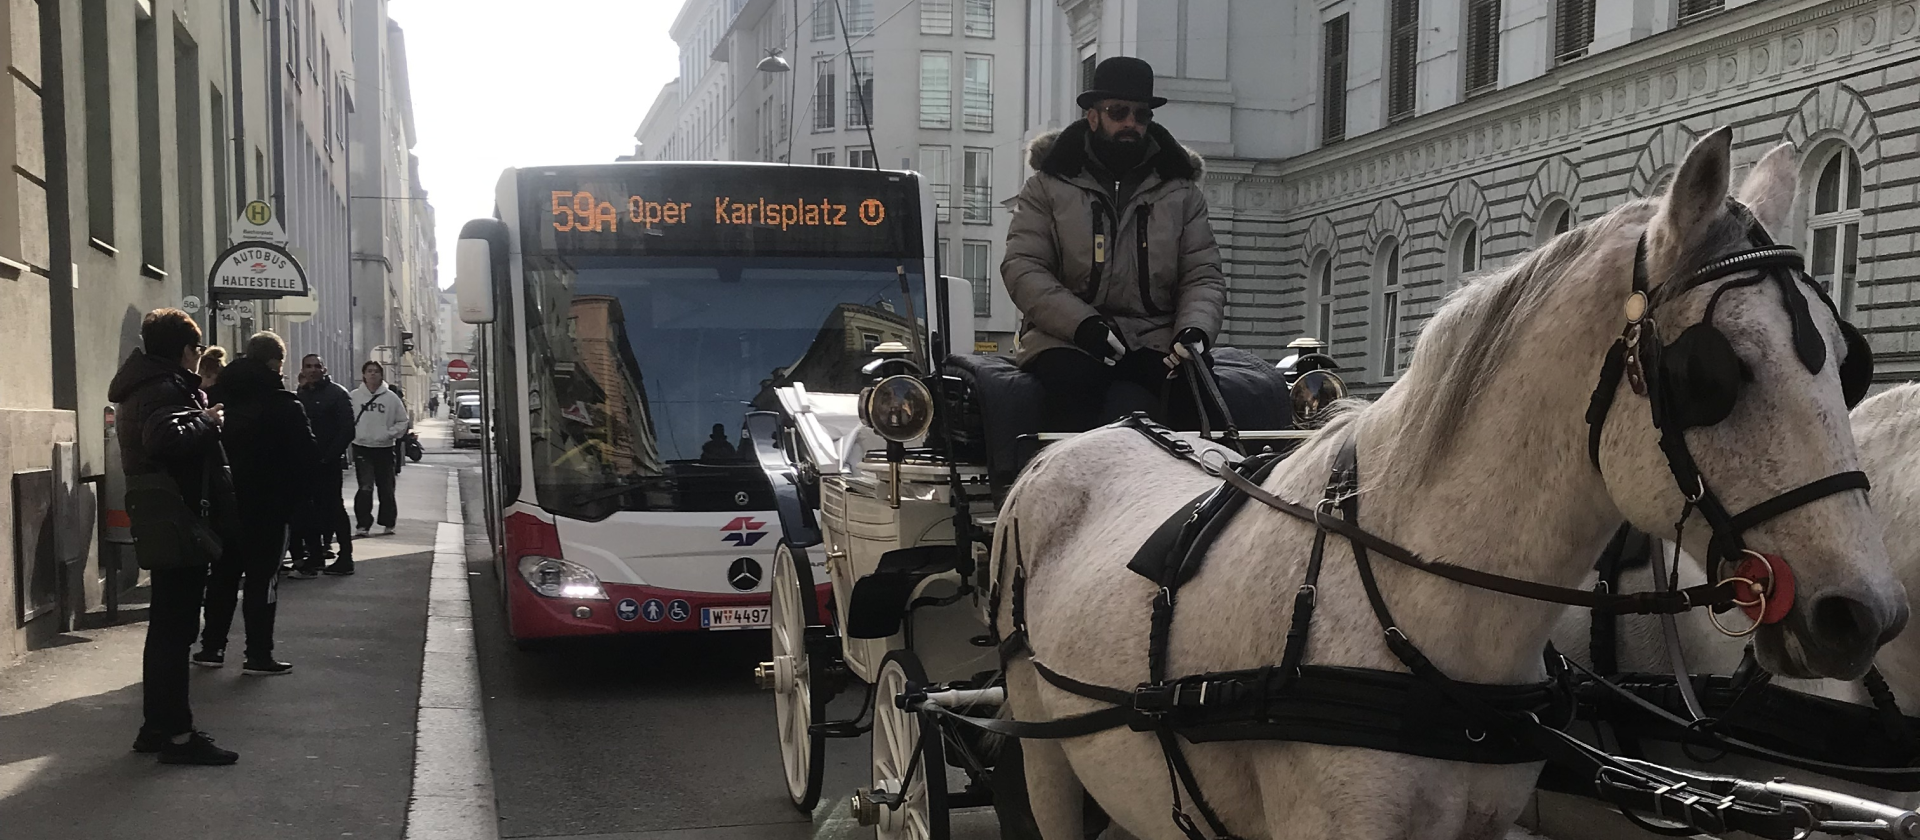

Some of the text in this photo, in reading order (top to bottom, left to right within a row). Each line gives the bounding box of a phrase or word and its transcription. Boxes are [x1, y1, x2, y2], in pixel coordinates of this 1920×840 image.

[251, 205, 265, 221] H
[551, 190, 617, 232] 59A
[629, 195, 692, 228] Oper
[715, 196, 847, 231] Karlsplatz
[233, 249, 287, 269] AUTOBUS
[222, 275, 296, 289] HALTESTELLE
[183, 300, 199, 309] 59A
[712, 609, 769, 624] W 4497
